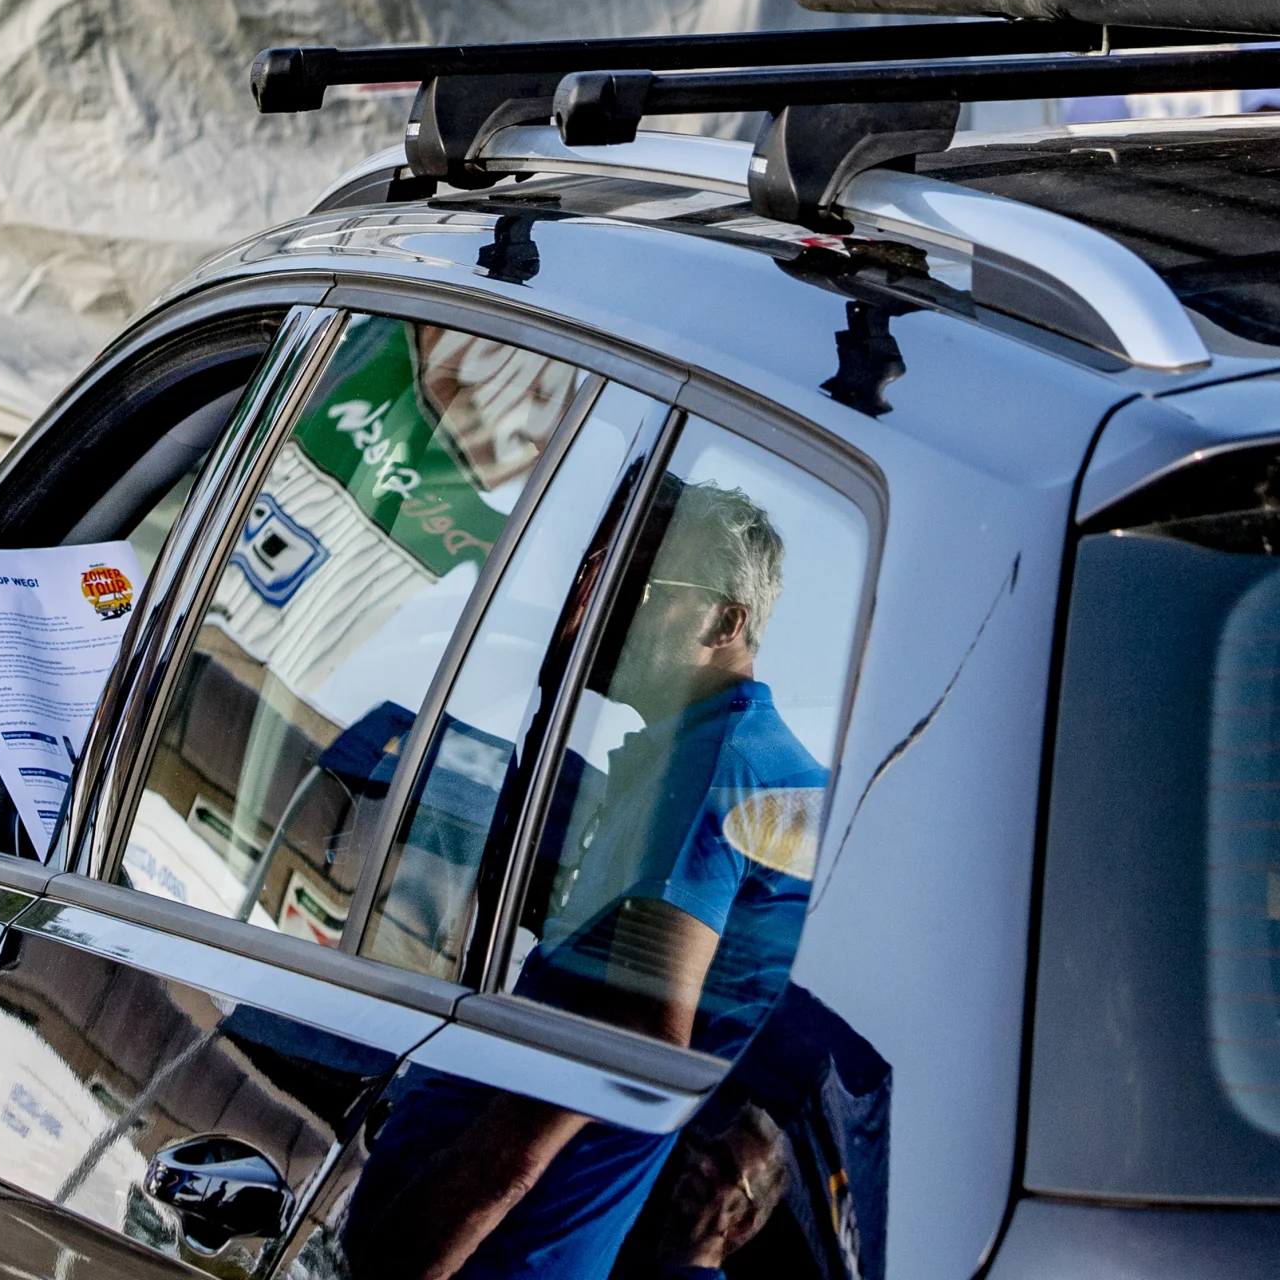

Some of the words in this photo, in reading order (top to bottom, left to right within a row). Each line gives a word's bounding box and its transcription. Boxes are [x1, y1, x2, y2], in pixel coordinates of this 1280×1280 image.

[10, 577, 40, 589] WEG!
[81, 568, 122, 583] ZOMER
[85, 579, 127, 597] TOUR
